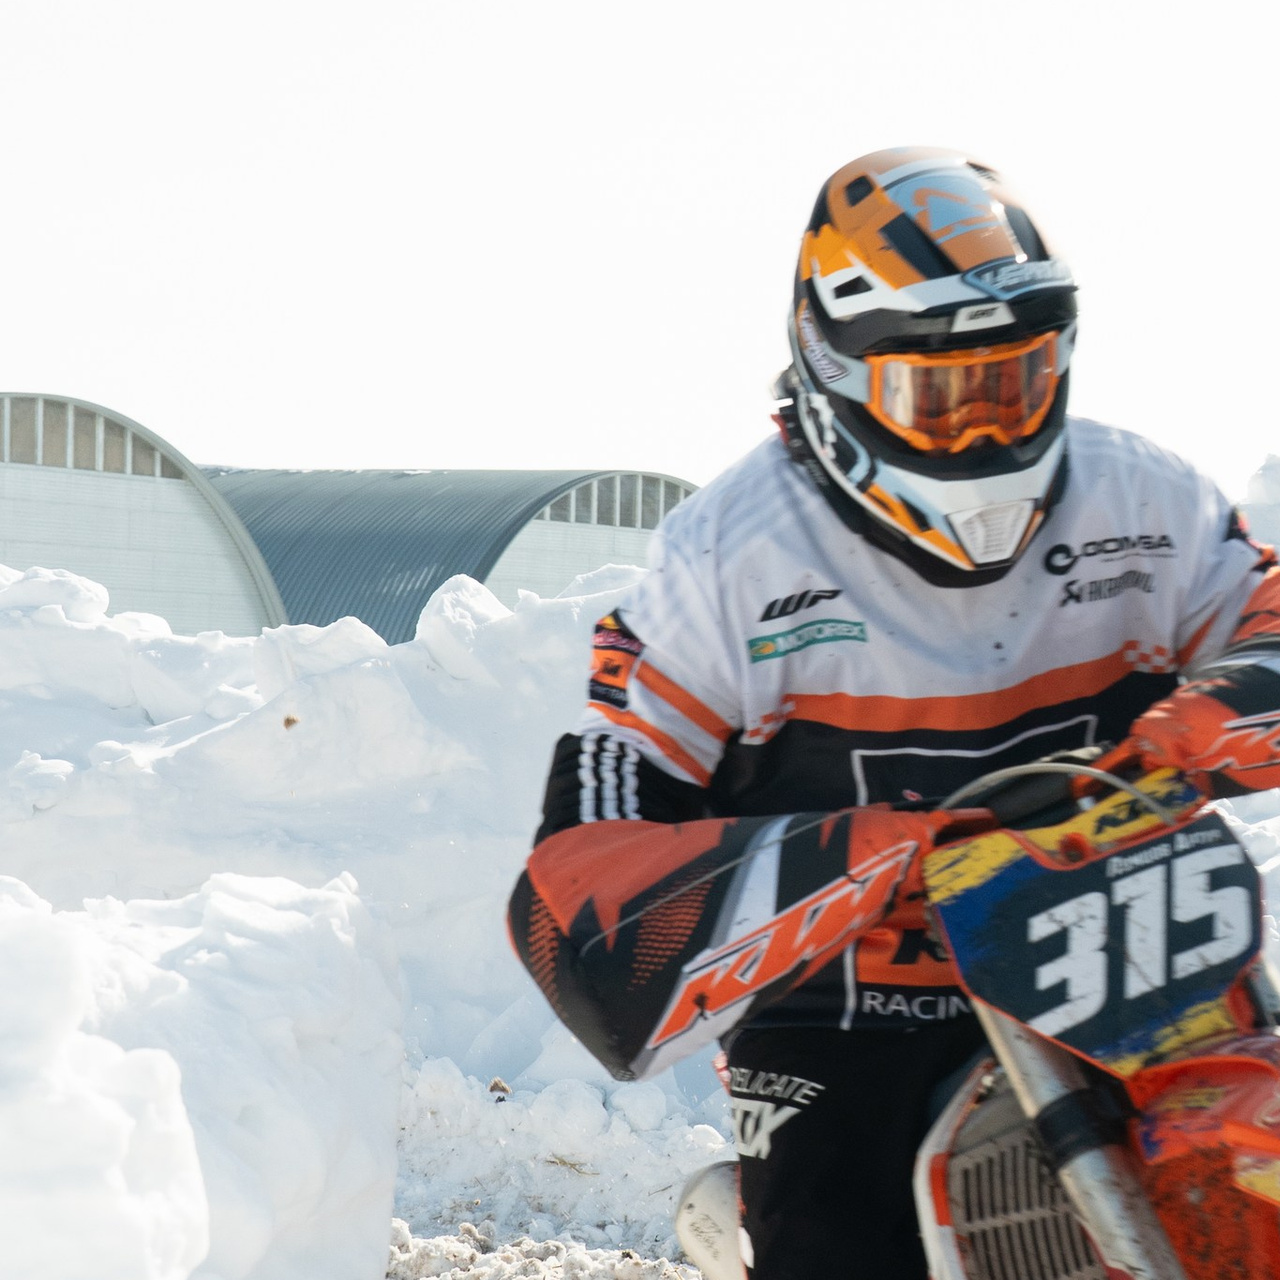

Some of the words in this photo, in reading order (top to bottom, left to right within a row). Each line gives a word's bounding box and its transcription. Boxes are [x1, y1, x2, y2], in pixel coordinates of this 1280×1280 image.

[758, 588, 843, 622] WP
[775, 621, 865, 654] MOTOREX
[646, 839, 919, 1050] KTM
[1026, 842, 1253, 1038] 315
[861, 990, 971, 1021] RACIN
